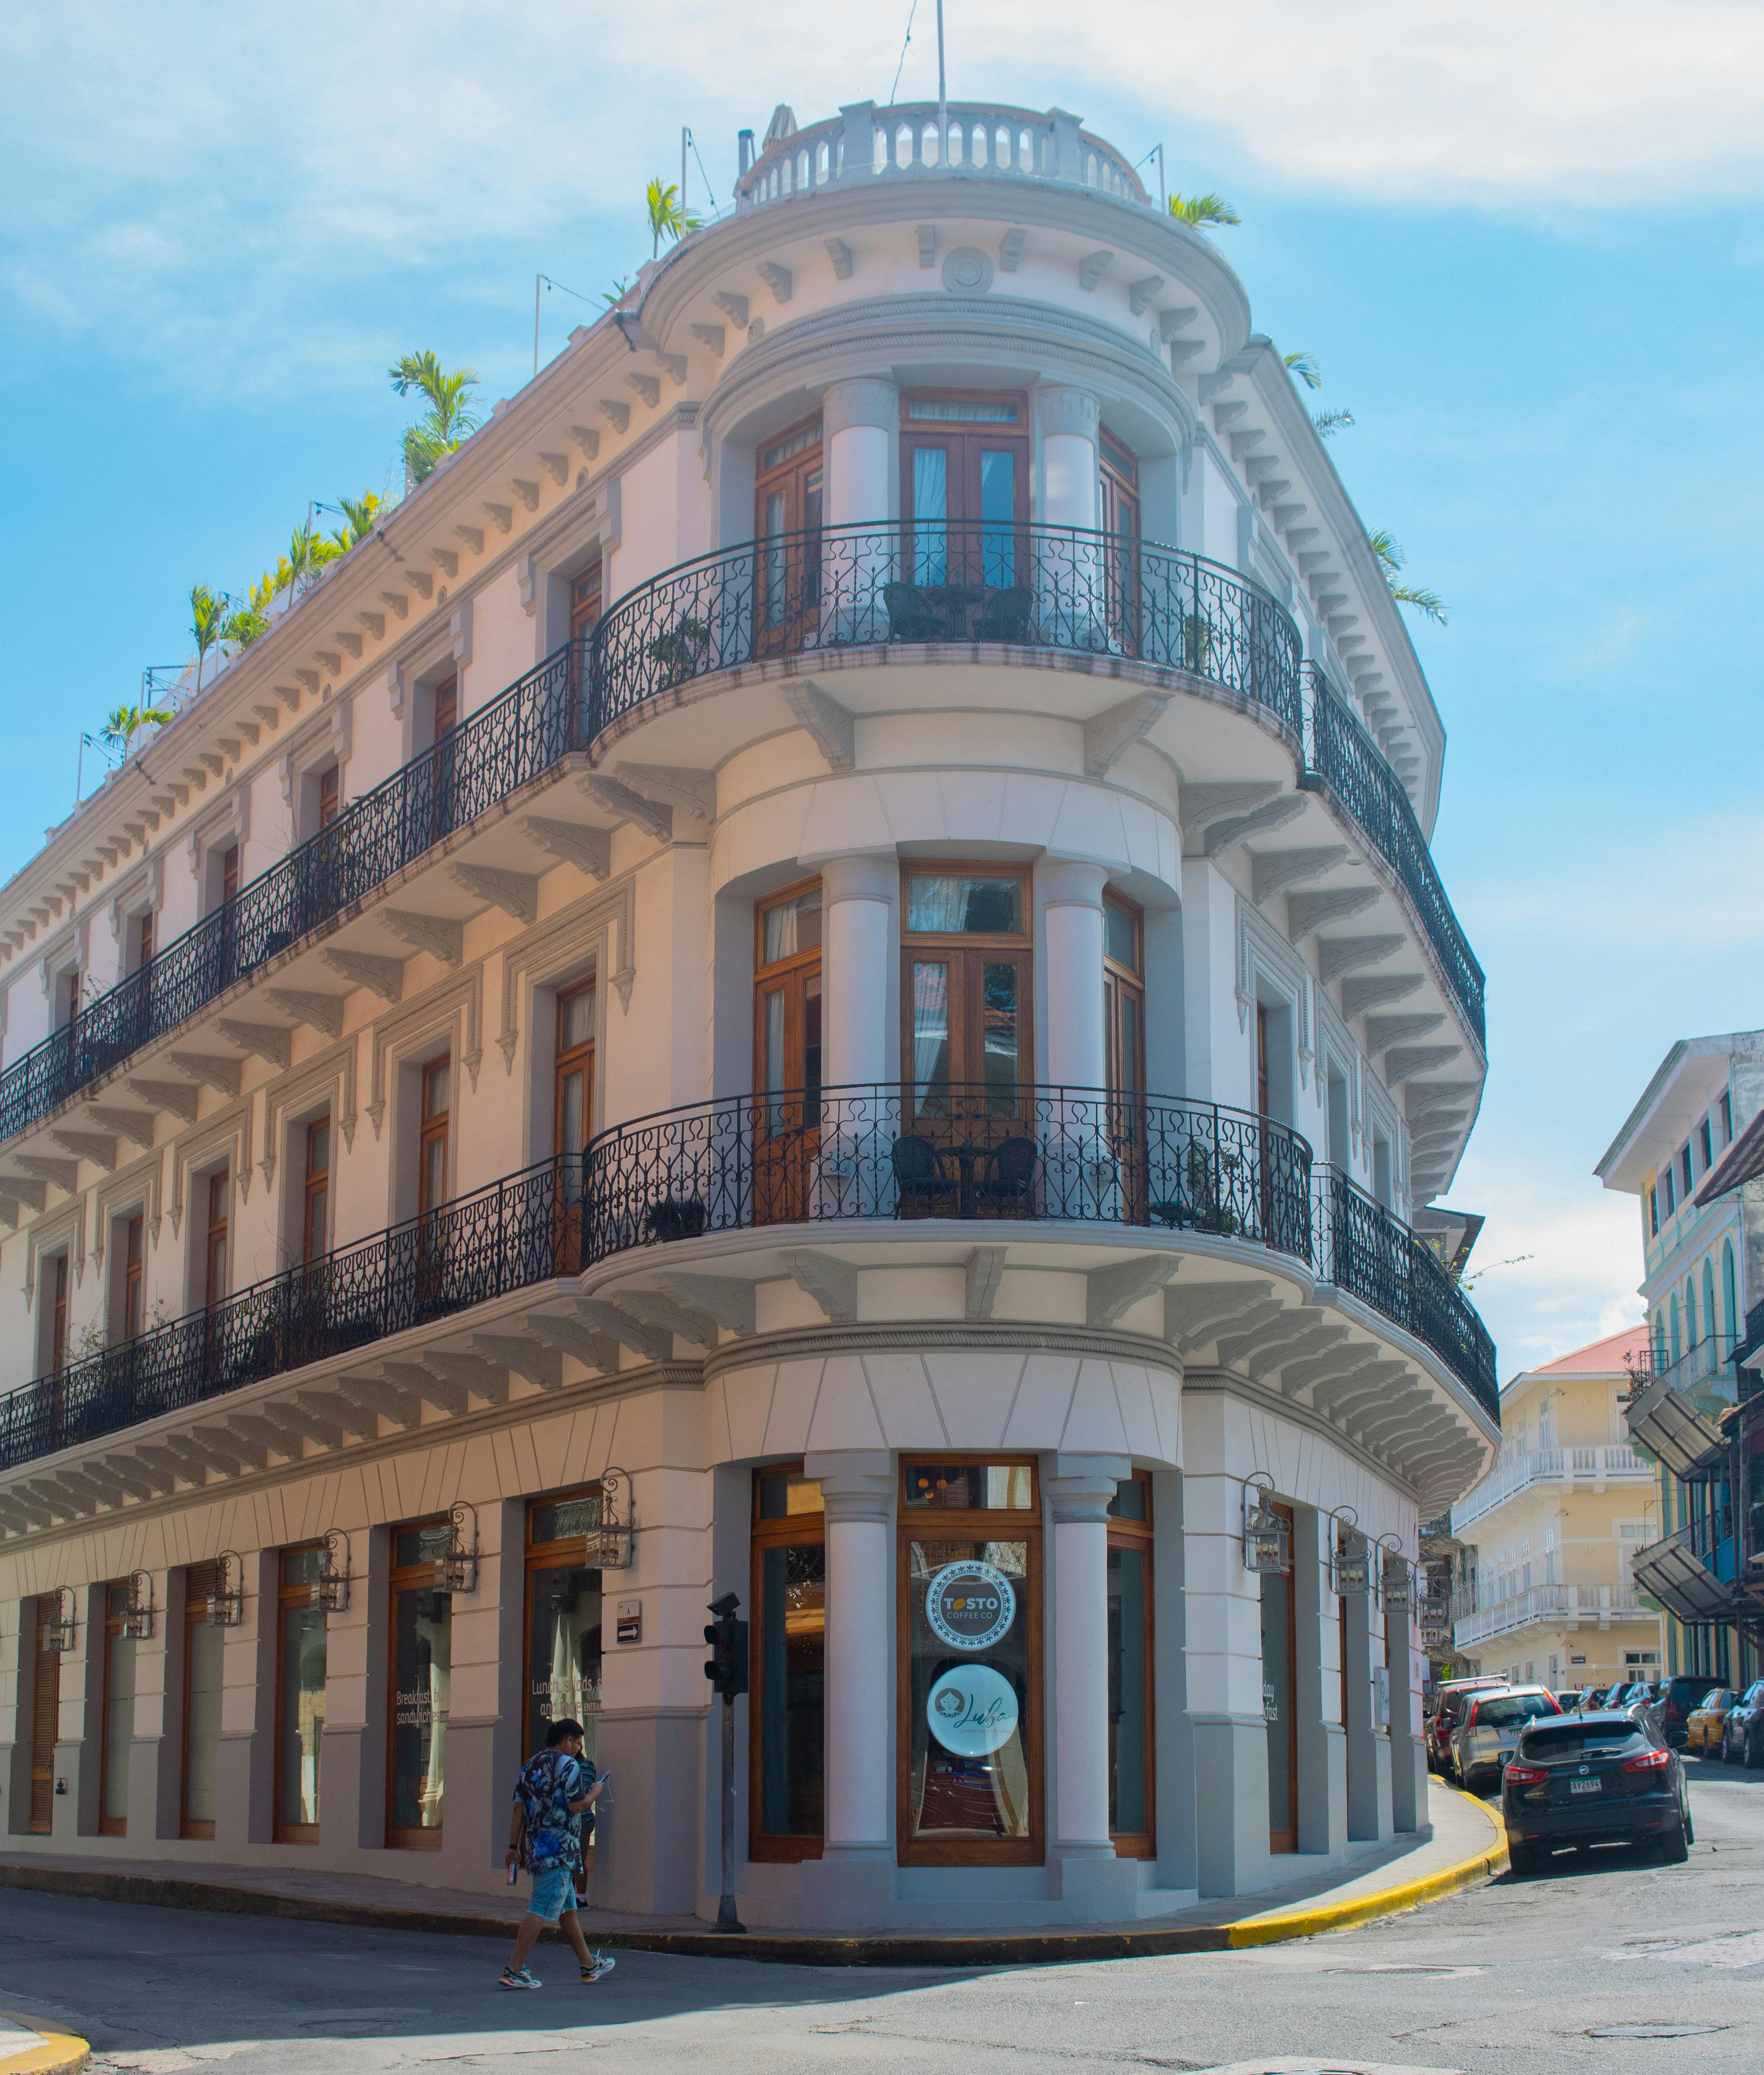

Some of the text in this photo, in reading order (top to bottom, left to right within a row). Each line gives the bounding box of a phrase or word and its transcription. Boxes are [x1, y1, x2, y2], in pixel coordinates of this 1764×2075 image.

[626, 1607, 630, 1615] A
[564, 1675, 595, 1694] salads,
[1262, 1679, 1274, 1702] day
[396, 1708, 440, 1724] sandwiches
[540, 1699, 557, 1716] and
[560, 1702, 581, 1715] more
[954, 1693, 1011, 1728] Luba
[1573, 1780, 1599, 1790] AY2694
